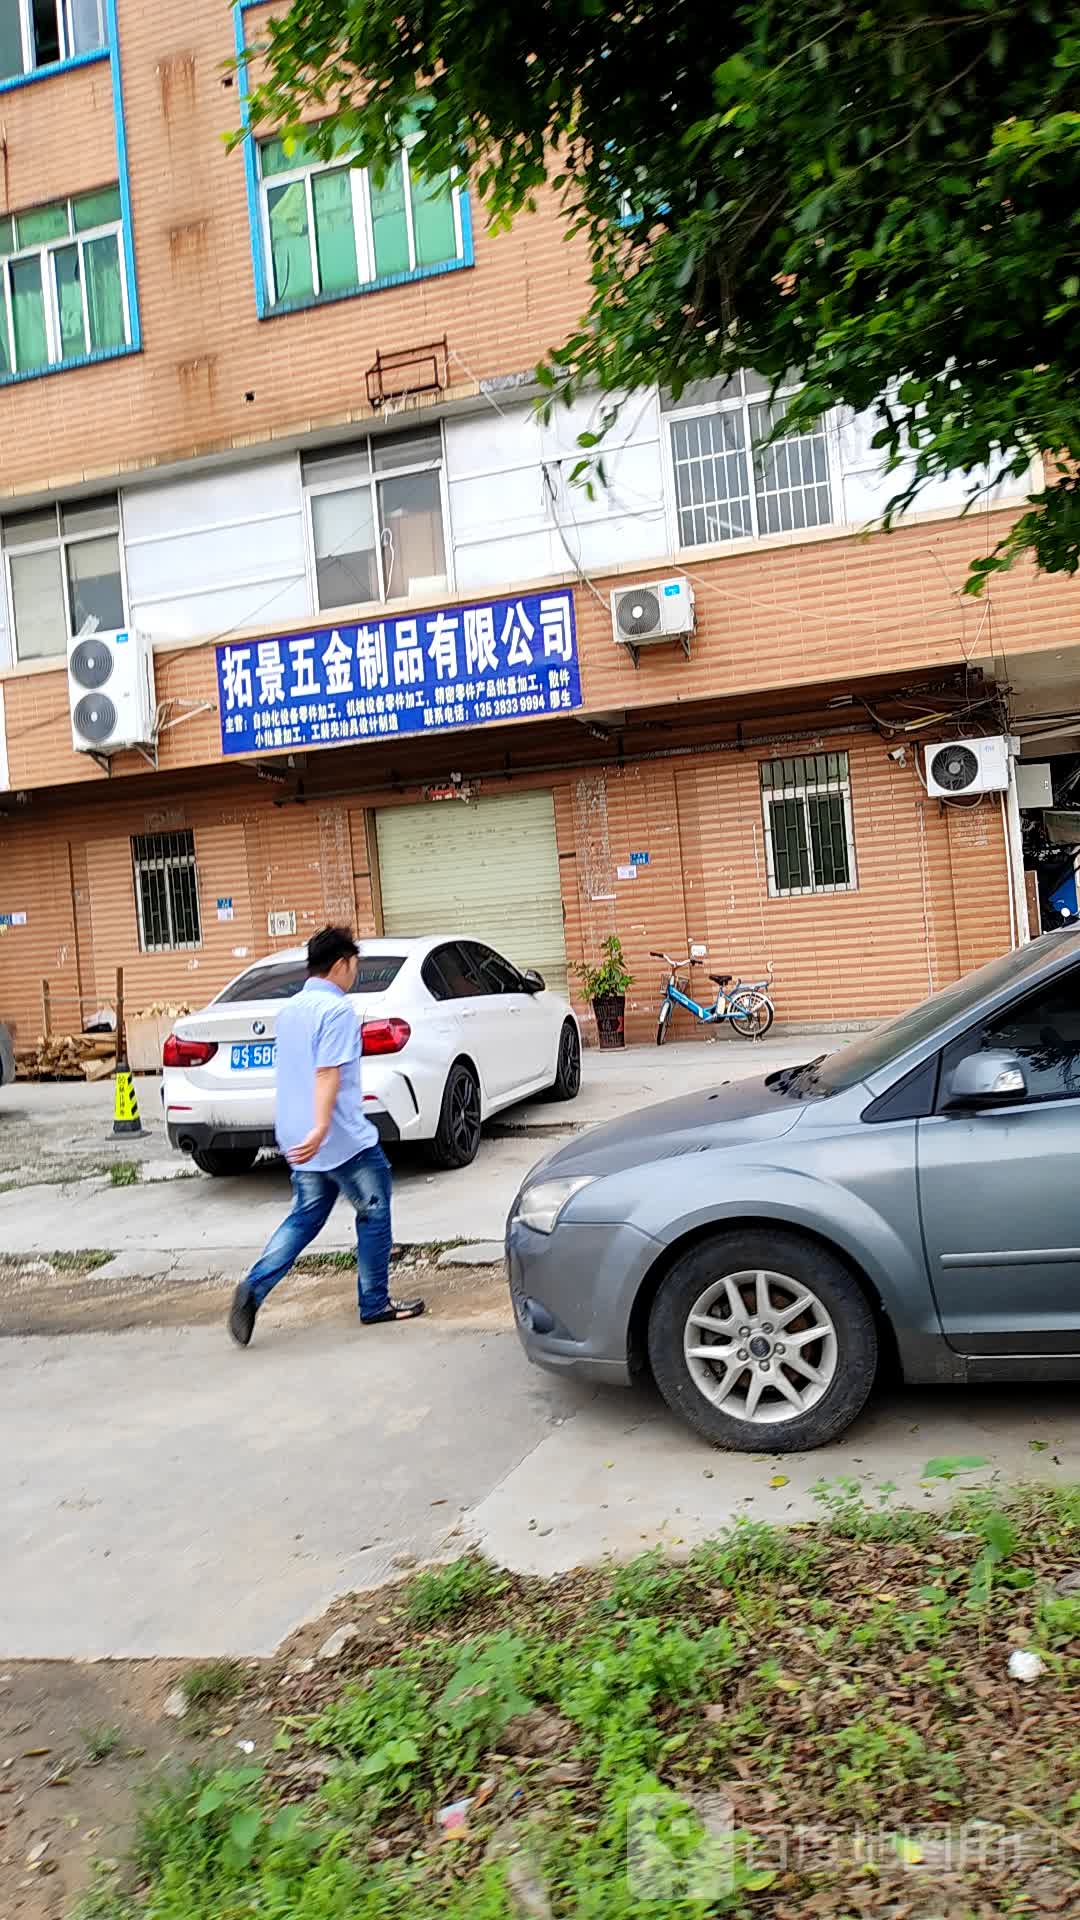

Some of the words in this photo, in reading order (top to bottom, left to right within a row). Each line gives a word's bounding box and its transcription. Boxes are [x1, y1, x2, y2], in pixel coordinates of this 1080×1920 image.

[222, 596, 573, 710] 拓景五金制品有限公司
